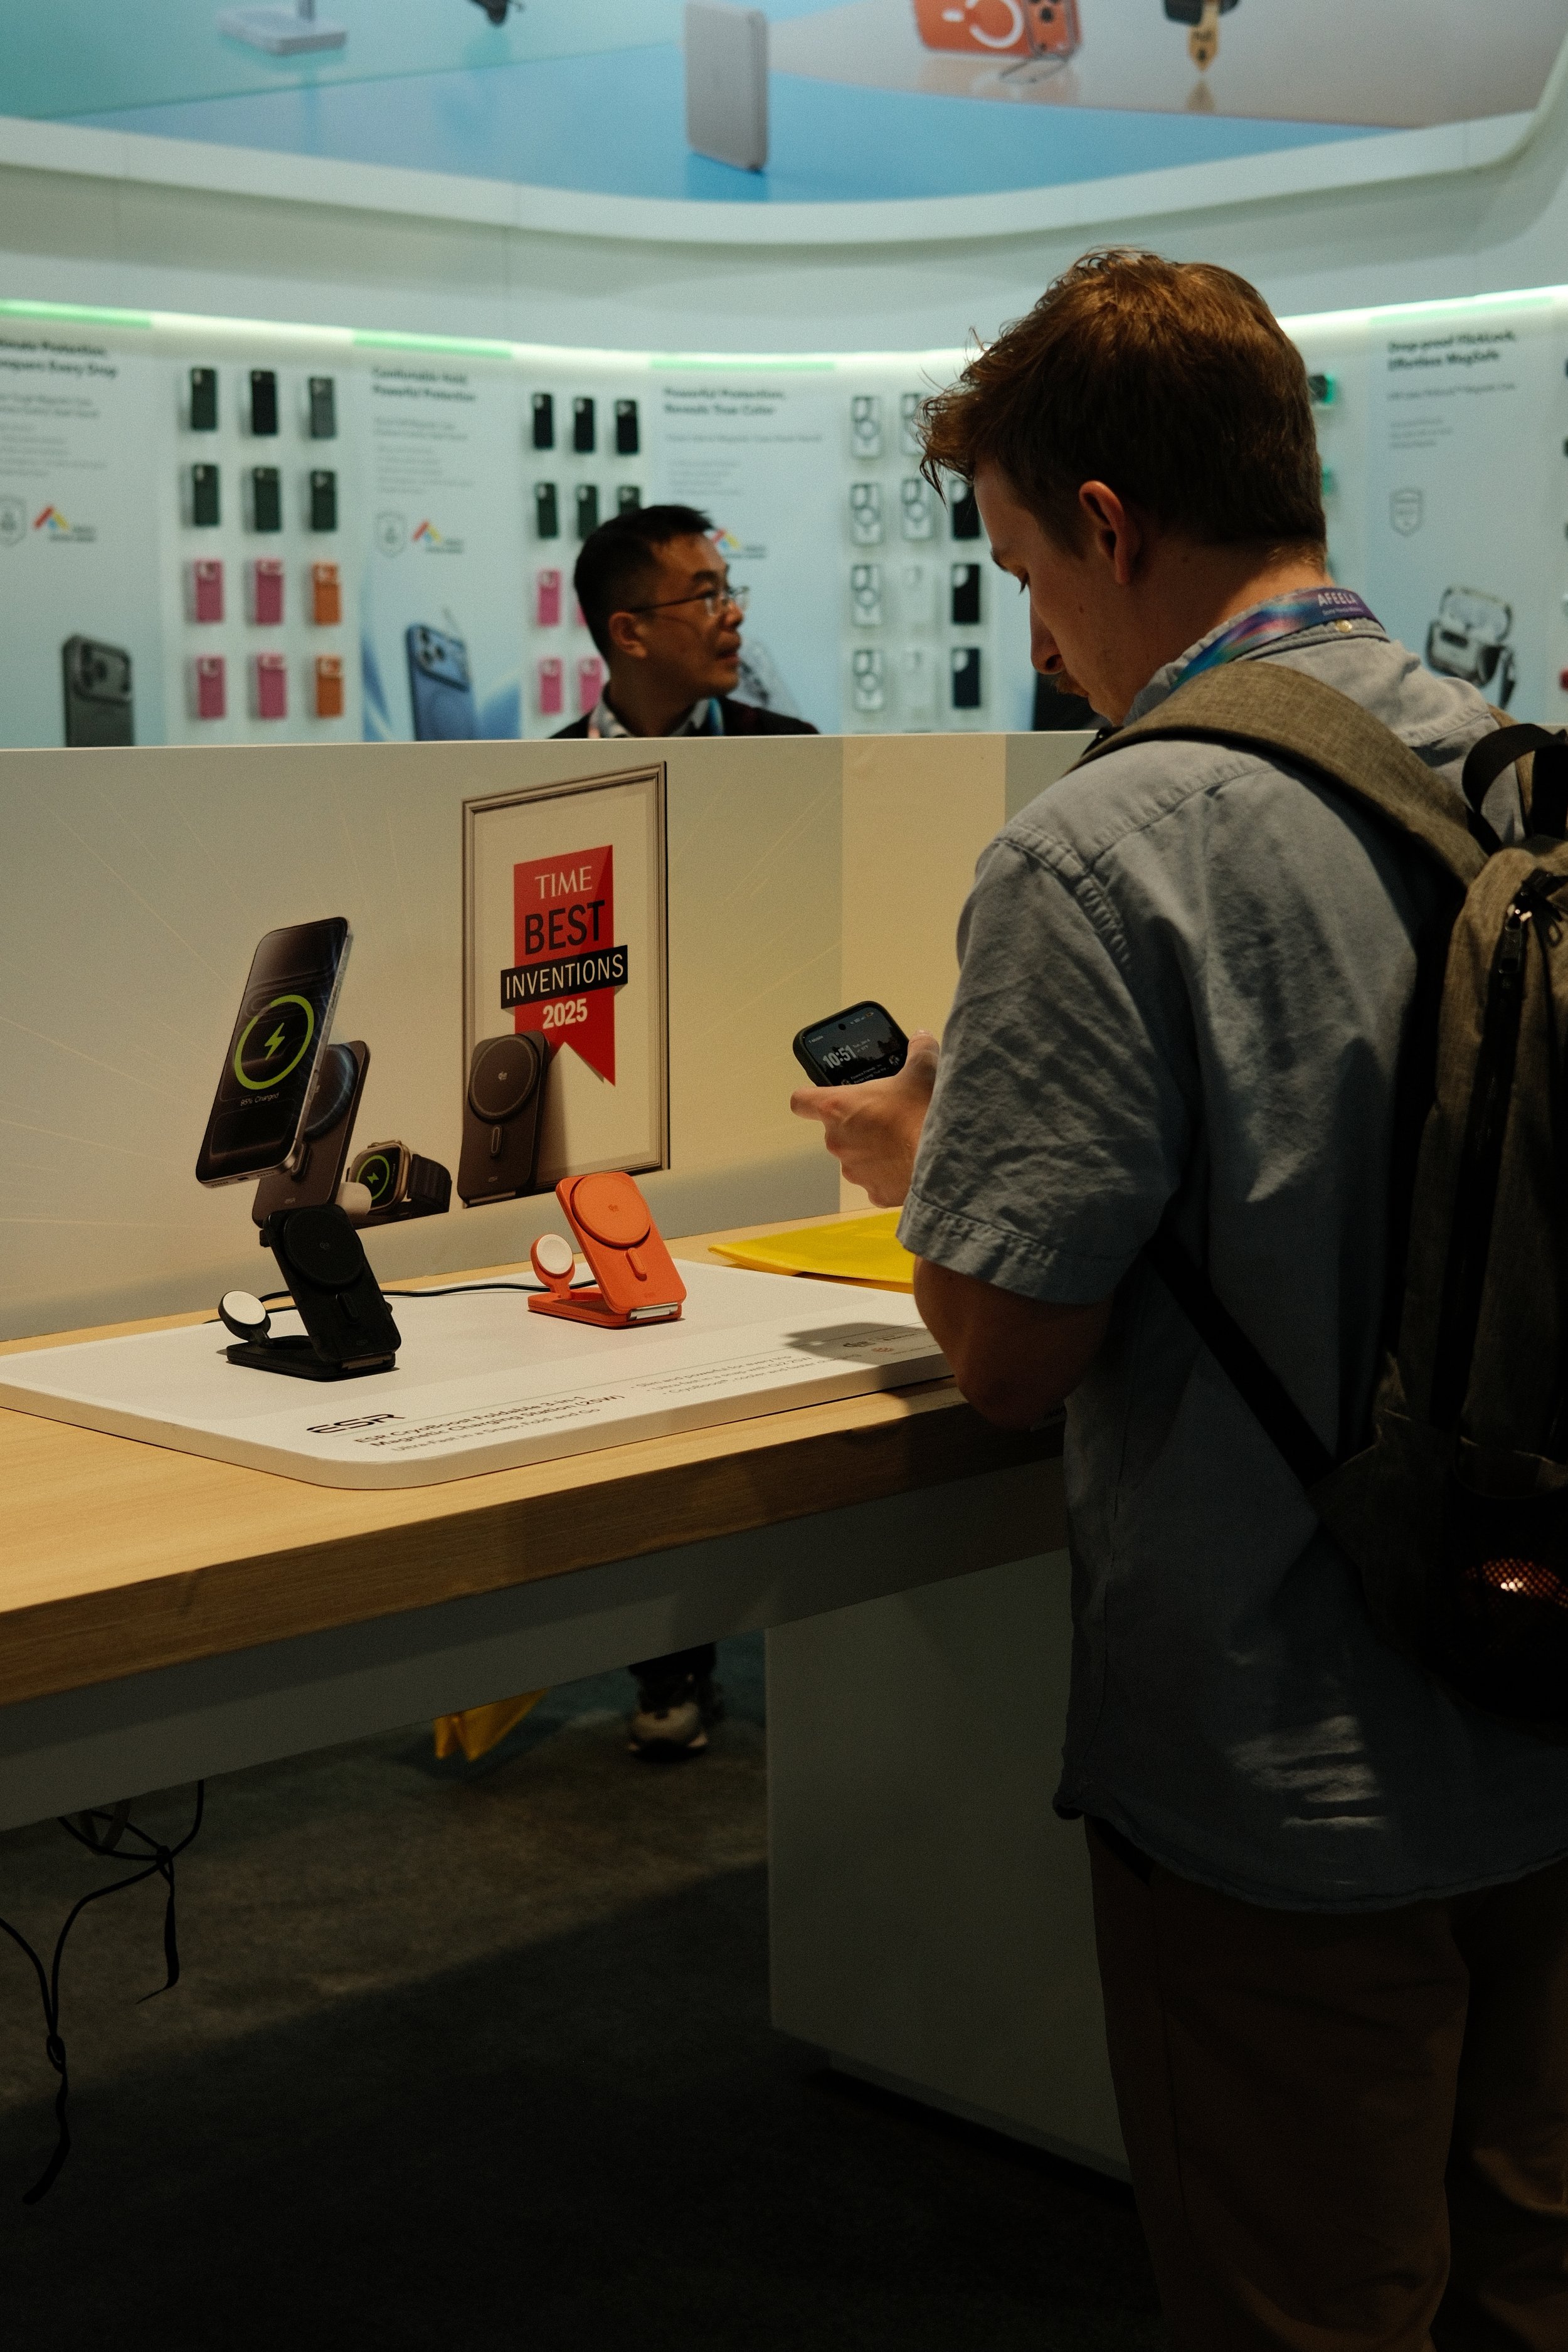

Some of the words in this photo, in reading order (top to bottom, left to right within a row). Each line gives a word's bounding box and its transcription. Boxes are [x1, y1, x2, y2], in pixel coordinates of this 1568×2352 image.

[1317, 592, 1359, 607] AFEELA
[535, 866, 592, 900] TIME
[524, 900, 605, 955] BEST
[506, 953, 625, 1000] INVENTIONS
[542, 998, 588, 1030] 2025
[823, 1045, 857, 1069] 10:51
[255, 1092, 280, 1103] Charged
[307, 1414, 406, 1434] ESR
[355, 1434, 388, 1443] ESR
[390, 1417, 474, 1437] CryoBoost
[474, 1405, 541, 1421] Foldable
[541, 1396, 585, 1407] 3-in-1
[370, 1430, 448, 1447] Magnetic
[448, 1414, 523, 1432] Charging
[521, 1404, 576, 1417] Station
[575, 1394, 625, 1407] (25W)
[391, 1435, 458, 1452] Ultra-Fast
[457, 1433, 474, 1441] in
[521, 1417, 553, 1428] Fold
[554, 1411, 579, 1420] and
